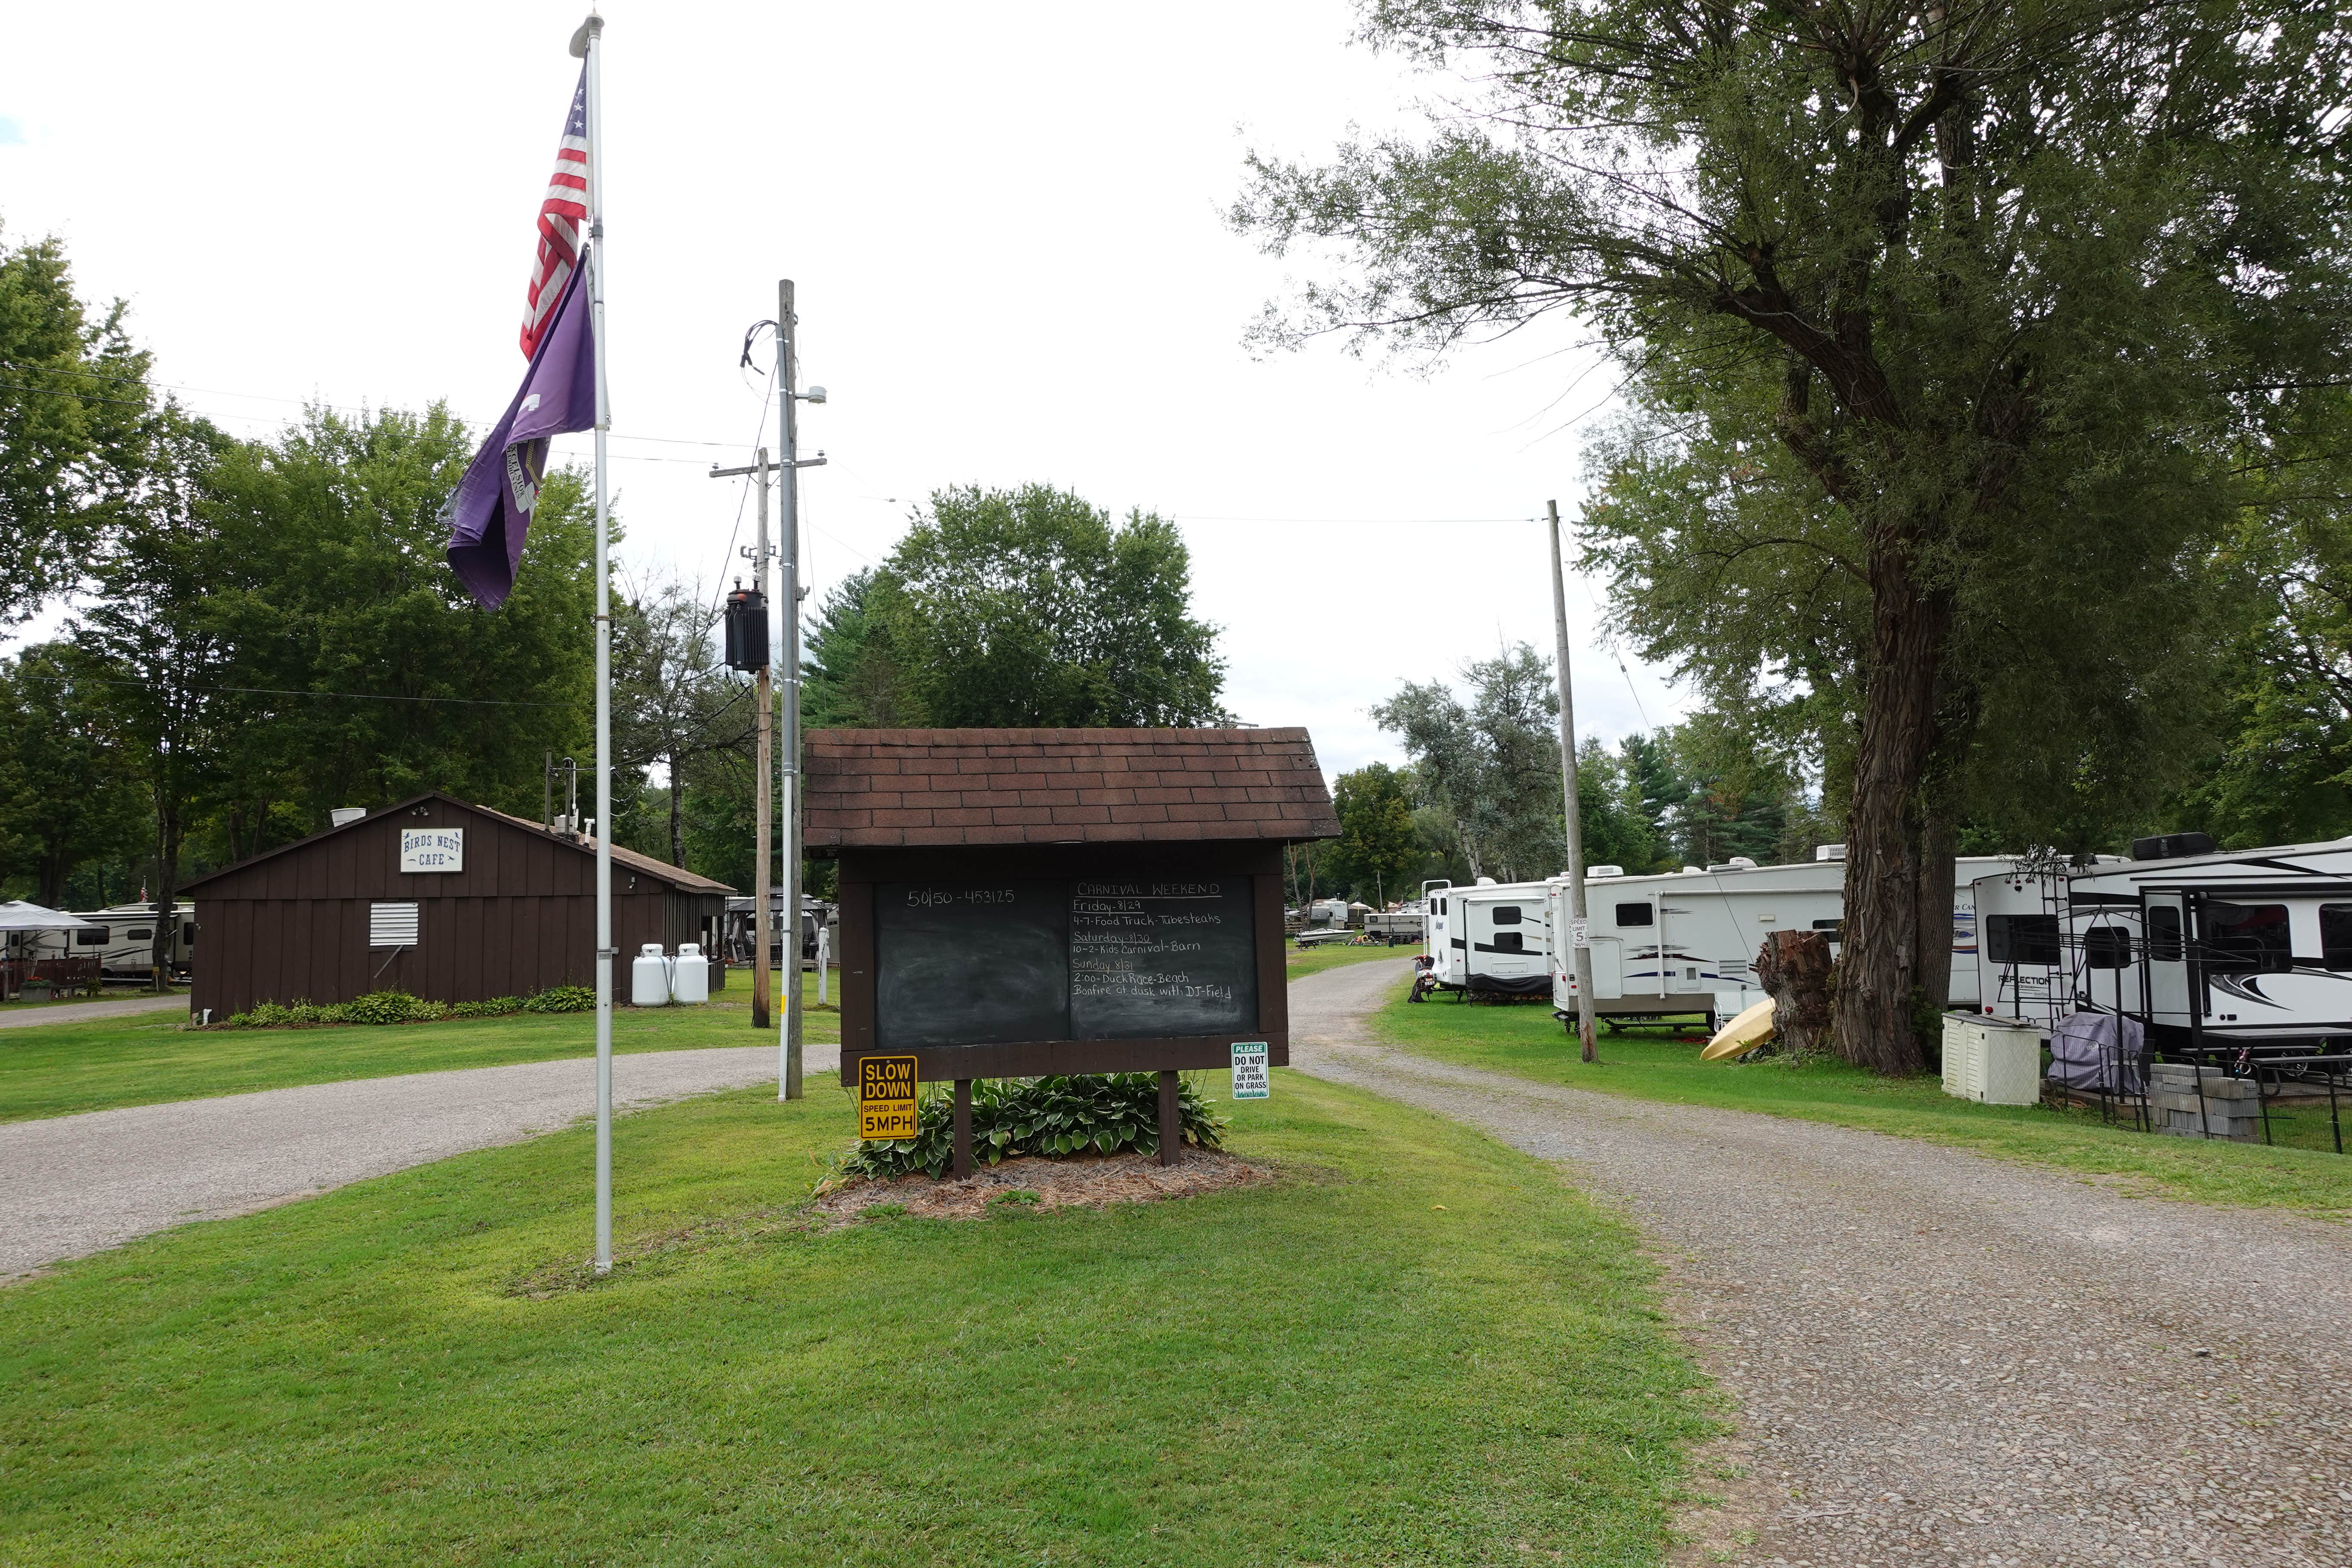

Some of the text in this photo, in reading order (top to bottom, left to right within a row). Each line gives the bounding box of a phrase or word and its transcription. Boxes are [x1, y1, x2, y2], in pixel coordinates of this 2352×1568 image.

[404, 835, 460, 853] BIRDS NEST
[420, 854, 444, 865] CAFE
[1078, 882, 1220, 895] CARNIVAL WEEKEND
[965, 890, 1014, 904] 453125
[1577, 932, 1583, 941] 5
[1073, 958, 1110, 974] Sunday
[1072, 984, 1110, 995] Bonfire
[1117, 986, 1127, 995] at
[1131, 986, 1155, 996] dusk
[1160, 985, 1183, 996] with
[1235, 1056, 1265, 1065] DO NOT
[866, 1064, 910, 1081] SLOW
[866, 1081, 910, 1098] DOWN
